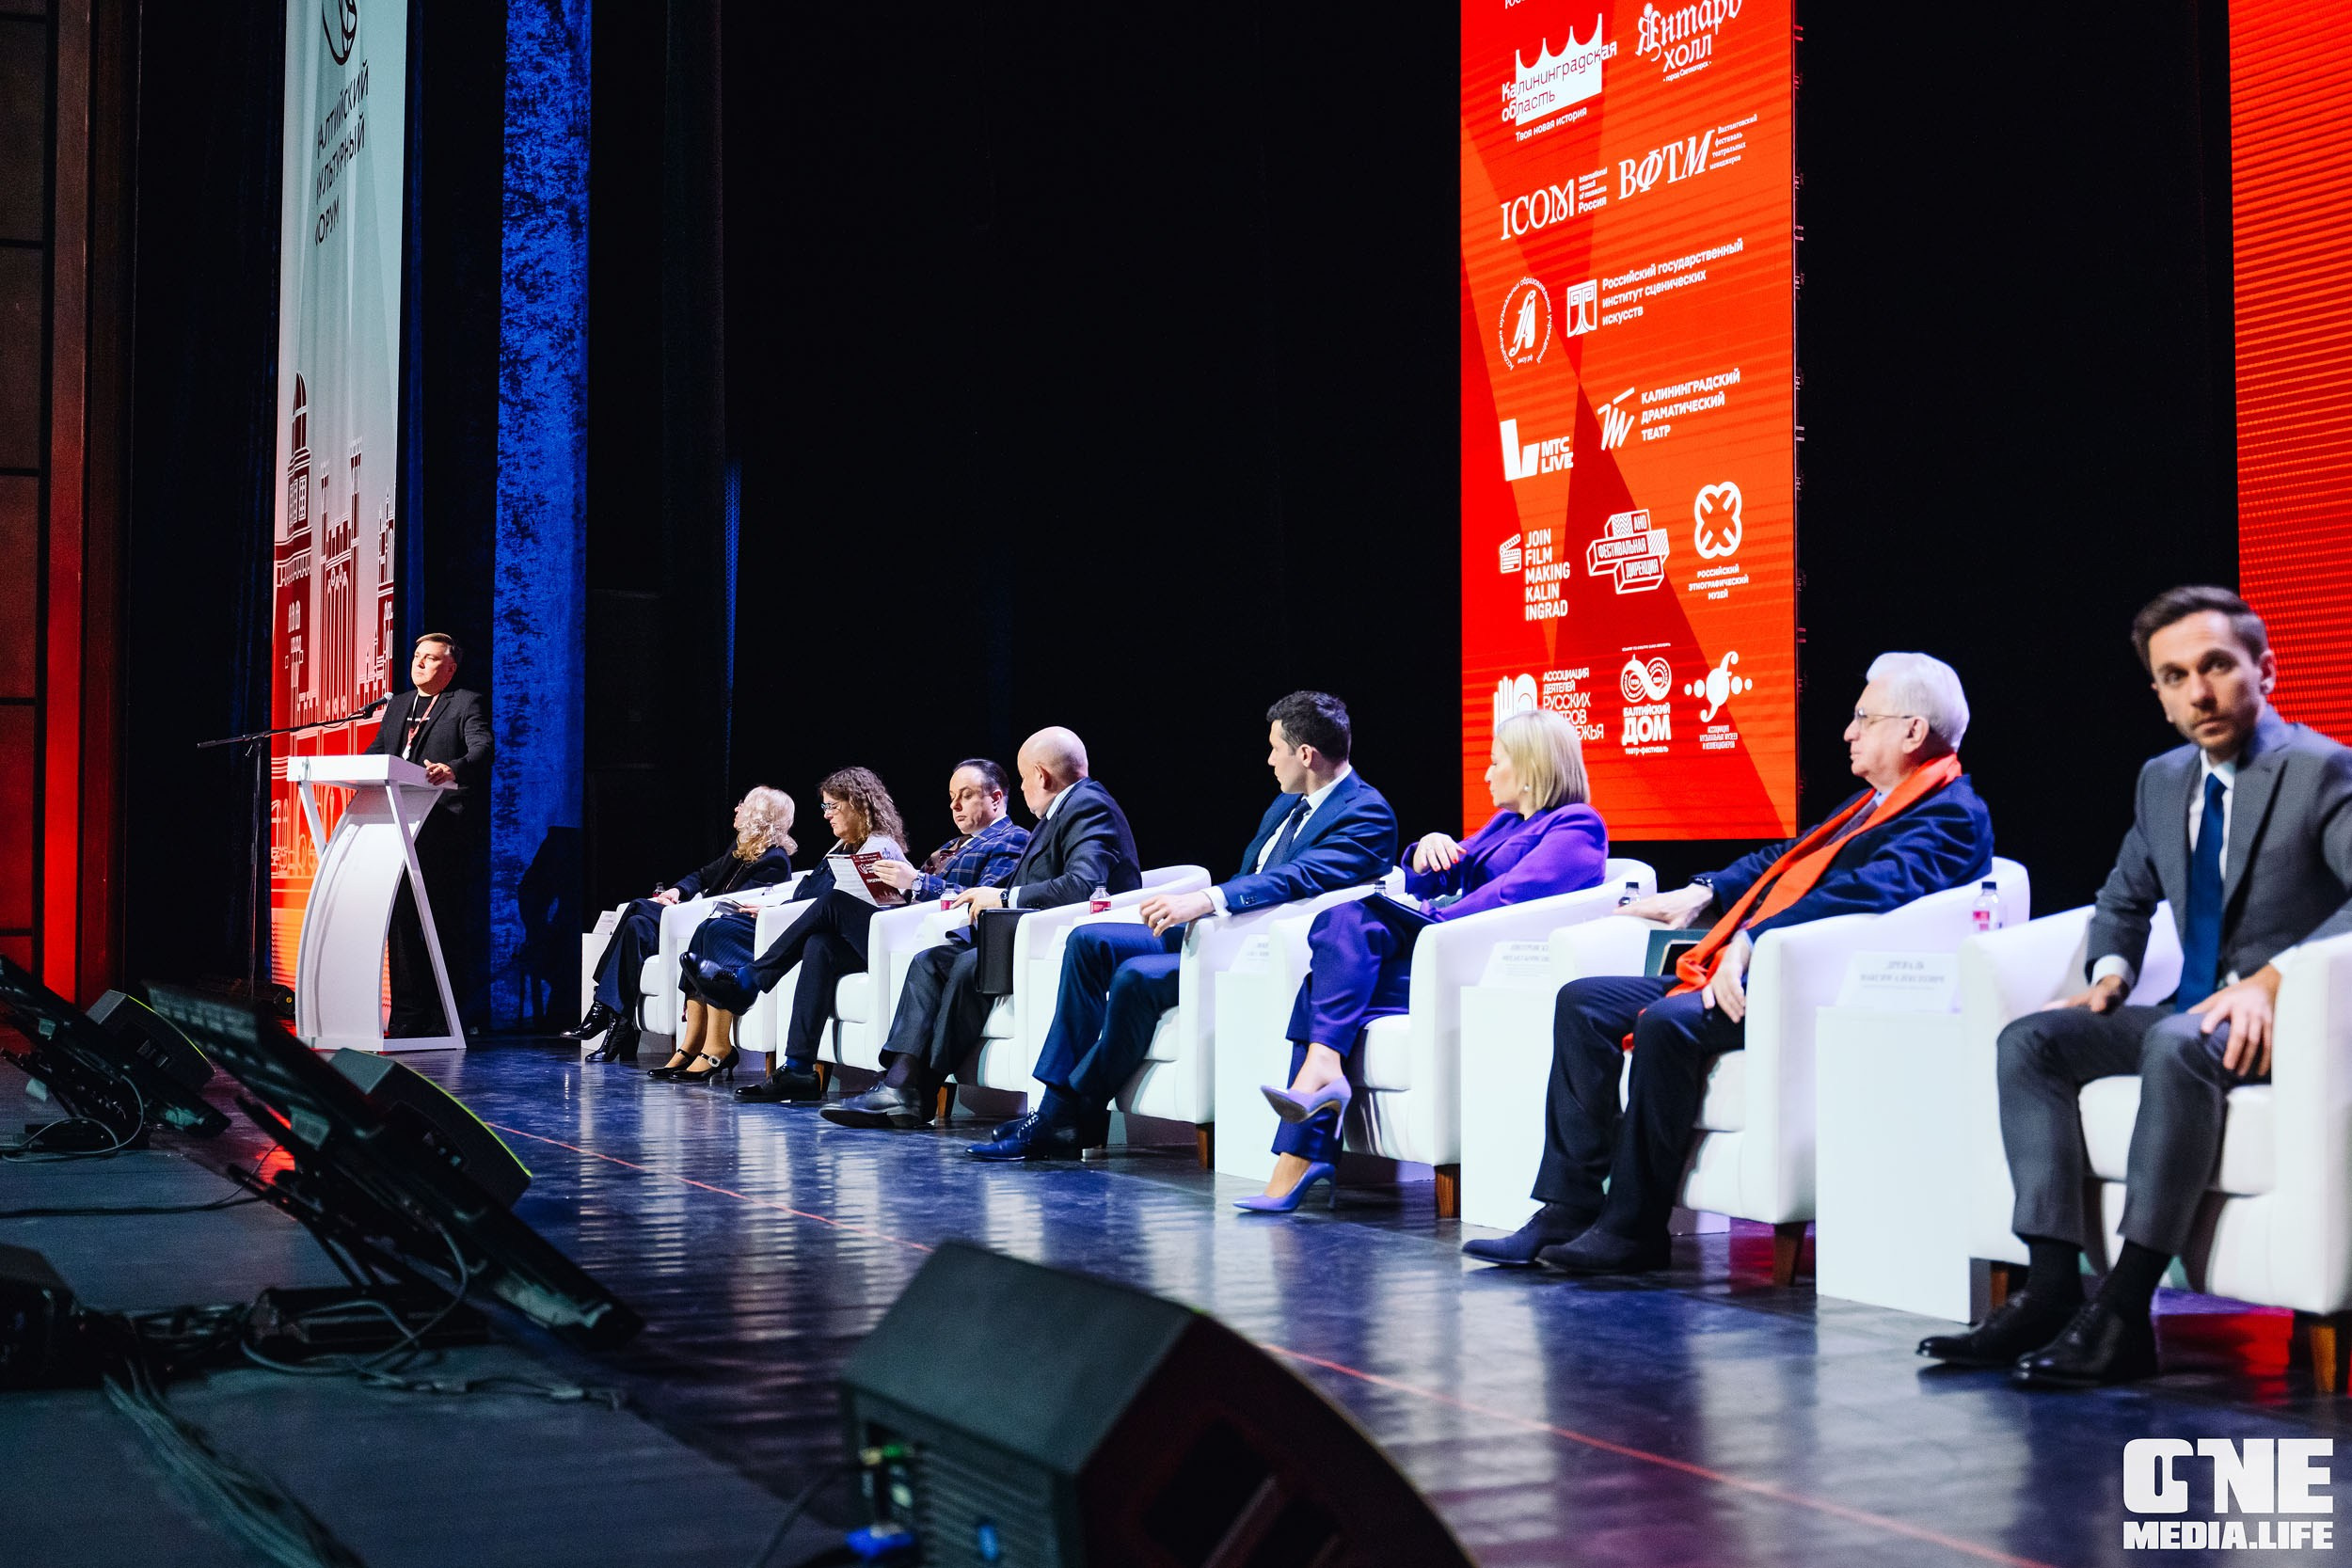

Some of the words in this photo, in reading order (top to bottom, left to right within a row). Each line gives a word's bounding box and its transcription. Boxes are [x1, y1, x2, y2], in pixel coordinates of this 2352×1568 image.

[1662, 34, 1712, 72] ХОЛЛ
[1502, 40, 1617, 103] Калининградская
[317, 59, 368, 159] АЛТИЙСКИЙ
[1502, 89, 1556, 122] область
[1516, 129, 1533, 142] Твоя
[1534, 119, 1555, 135] новая
[1556, 107, 1587, 127] история
[316, 111, 364, 206] УЛЬТУРНЫЙ
[1618, 130, 1715, 200] ВФТМ
[1501, 179, 1575, 241] ICOM
[1579, 197, 1607, 214] Россия
[1602, 263, 1657, 291] Российский
[1658, 237, 1743, 275] государственный
[1602, 287, 1644, 309] институт
[1645, 270, 1707, 297] сценических
[1602, 306, 1644, 325] искусств
[1641, 368, 1740, 404] КАЛИНИНГРАДСКИЙ
[1641, 390, 1725, 425] ДРАМАТИЧЕСКИЙ
[1641, 425, 1671, 441] ТЕАТР
[1541, 451, 1574, 474] LIVE
[1633, 515, 1647, 531] АНО
[1525, 528, 1551, 548] JOIN
[1597, 537, 1647, 559] ФЕСТИВАЛЬНАЯ
[1525, 546, 1552, 566] FILM
[1525, 562, 1570, 585] MAKING
[1625, 558, 1660, 579] ДИРЕКЦИЯ
[1696, 562, 1740, 578] РОССИЙСКИЙ
[1525, 582, 1560, 603] KALIN
[1688, 574, 1749, 592] ЭТНОГРАФИЧЕСКИЙ
[1708, 588, 1728, 600] МУЗЕЙ
[1525, 599, 1568, 621] INGRAD
[1543, 667, 1589, 682] АССОЦИАЦИЯ
[1543, 679, 1576, 695] ДЕЯТЕЛЕЙ
[1543, 692, 1591, 710] РУССКИХ
[1623, 702, 1671, 717] БАЛТИЙСКИЙ
[1558, 709, 1587, 725] ТРОВ
[1622, 715, 1671, 746] ДОМ
